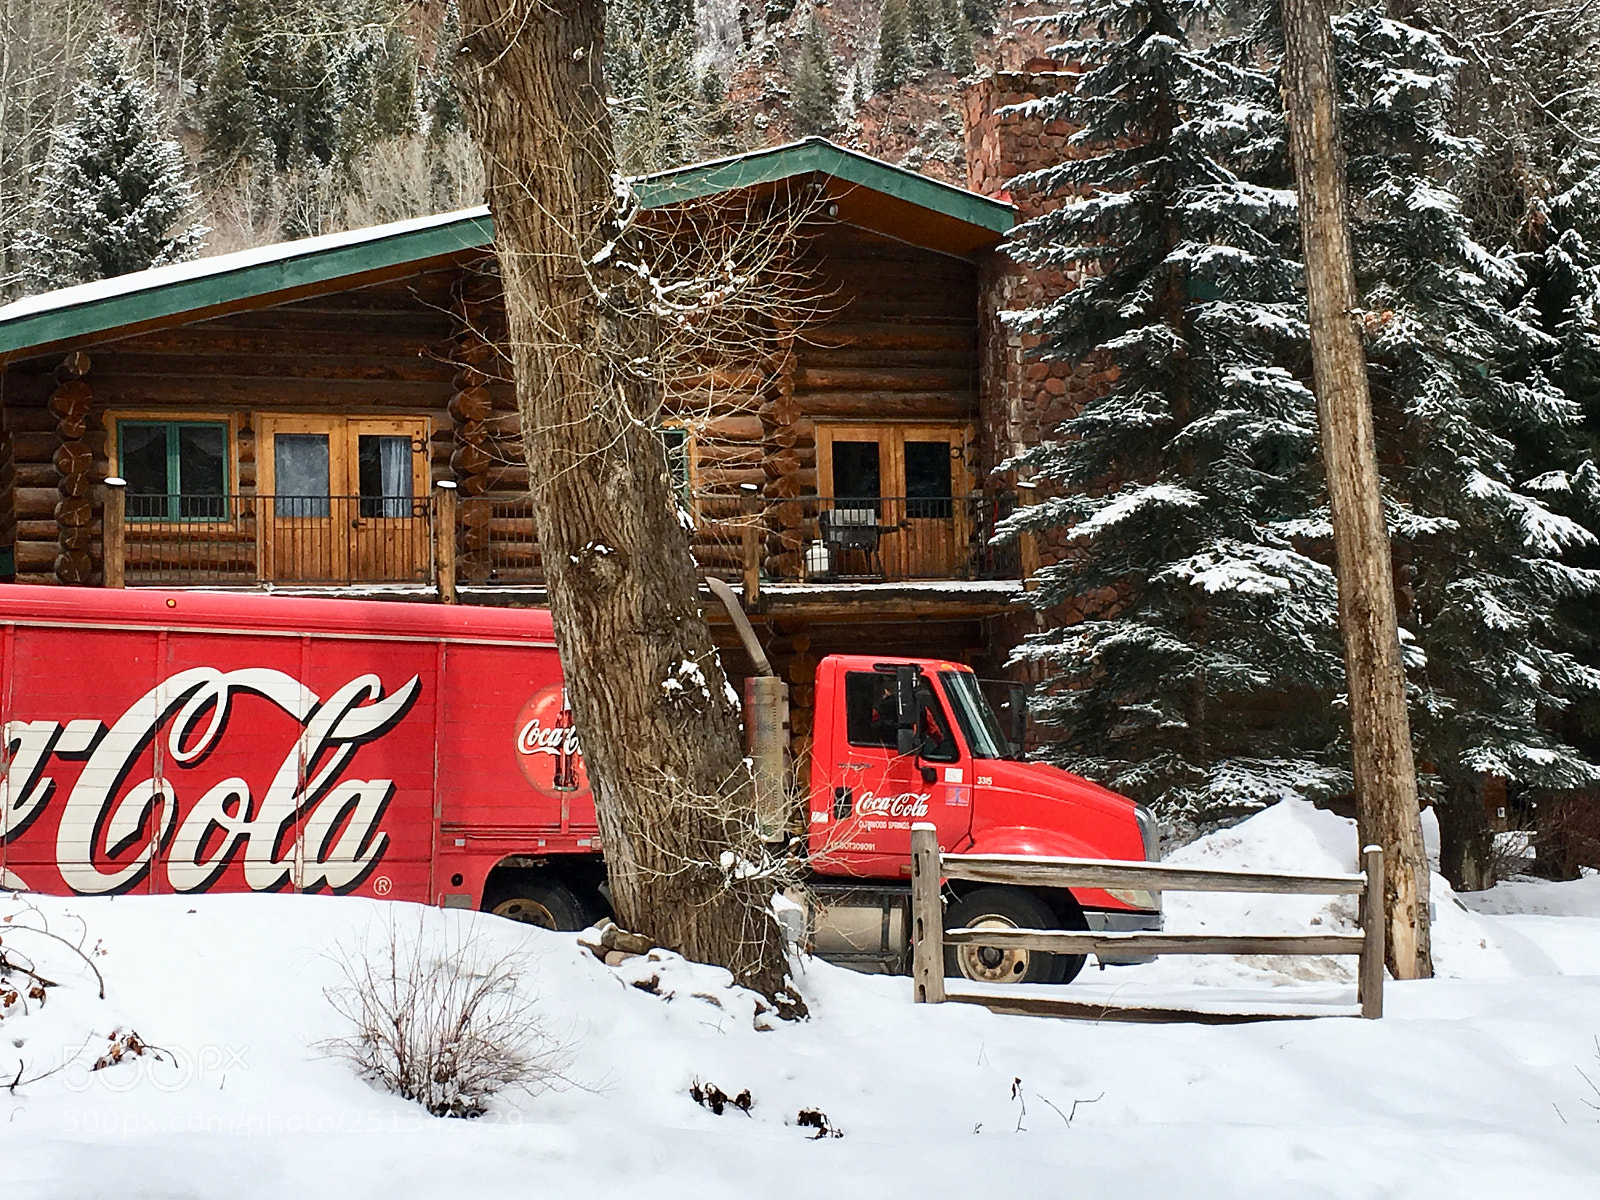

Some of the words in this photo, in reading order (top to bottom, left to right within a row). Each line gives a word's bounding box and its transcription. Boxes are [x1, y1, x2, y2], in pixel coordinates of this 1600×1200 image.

[517, 718, 583, 756] Coca-C
[977, 776, 993, 785] 3315
[856, 791, 931, 817] Coca-Cola
